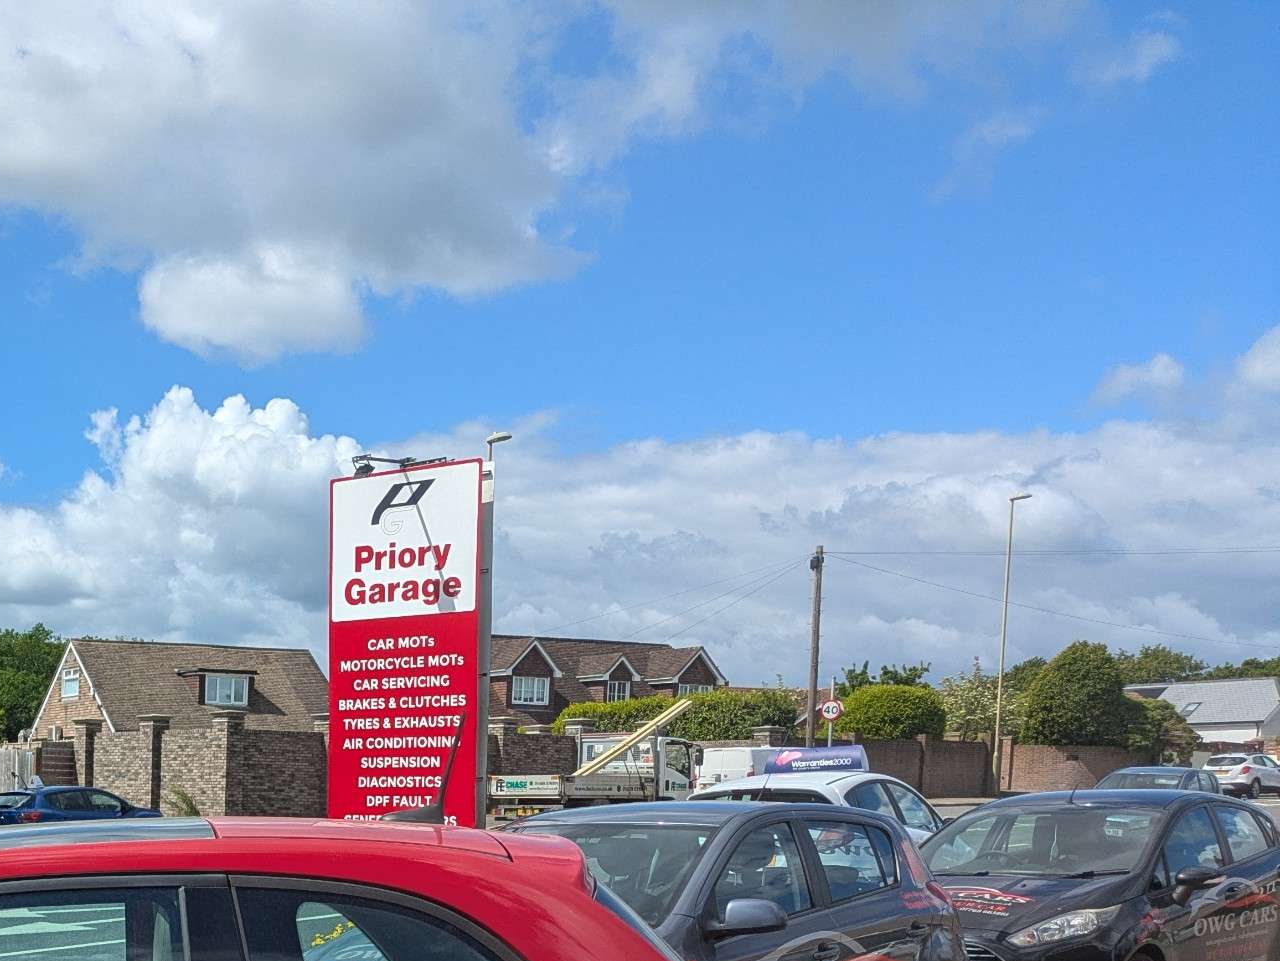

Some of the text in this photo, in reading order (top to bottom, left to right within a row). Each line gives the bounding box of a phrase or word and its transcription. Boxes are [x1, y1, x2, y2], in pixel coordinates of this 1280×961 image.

[354, 541, 452, 573] Priory
[344, 576, 462, 606] Garage
[367, 635, 435, 651] CAR MOTs
[340, 653, 465, 673] MOTORCYCLE MOTs
[353, 675, 450, 691] CAR SERVICING
[338, 694, 467, 711] BRAKES & CLUTCHES
[823, 705, 839, 715] 40
[343, 715, 461, 731] TYRES & EXHAUSTS
[342, 738, 363, 750] AIR
[360, 756, 441, 769] SUSPENSION
[357, 775, 442, 788] DIAGNOSTICS
[505, 780, 528, 789] CHASE
[366, 795, 432, 808] DPF FAULT
[1193, 904, 1278, 937] OWG CARS
